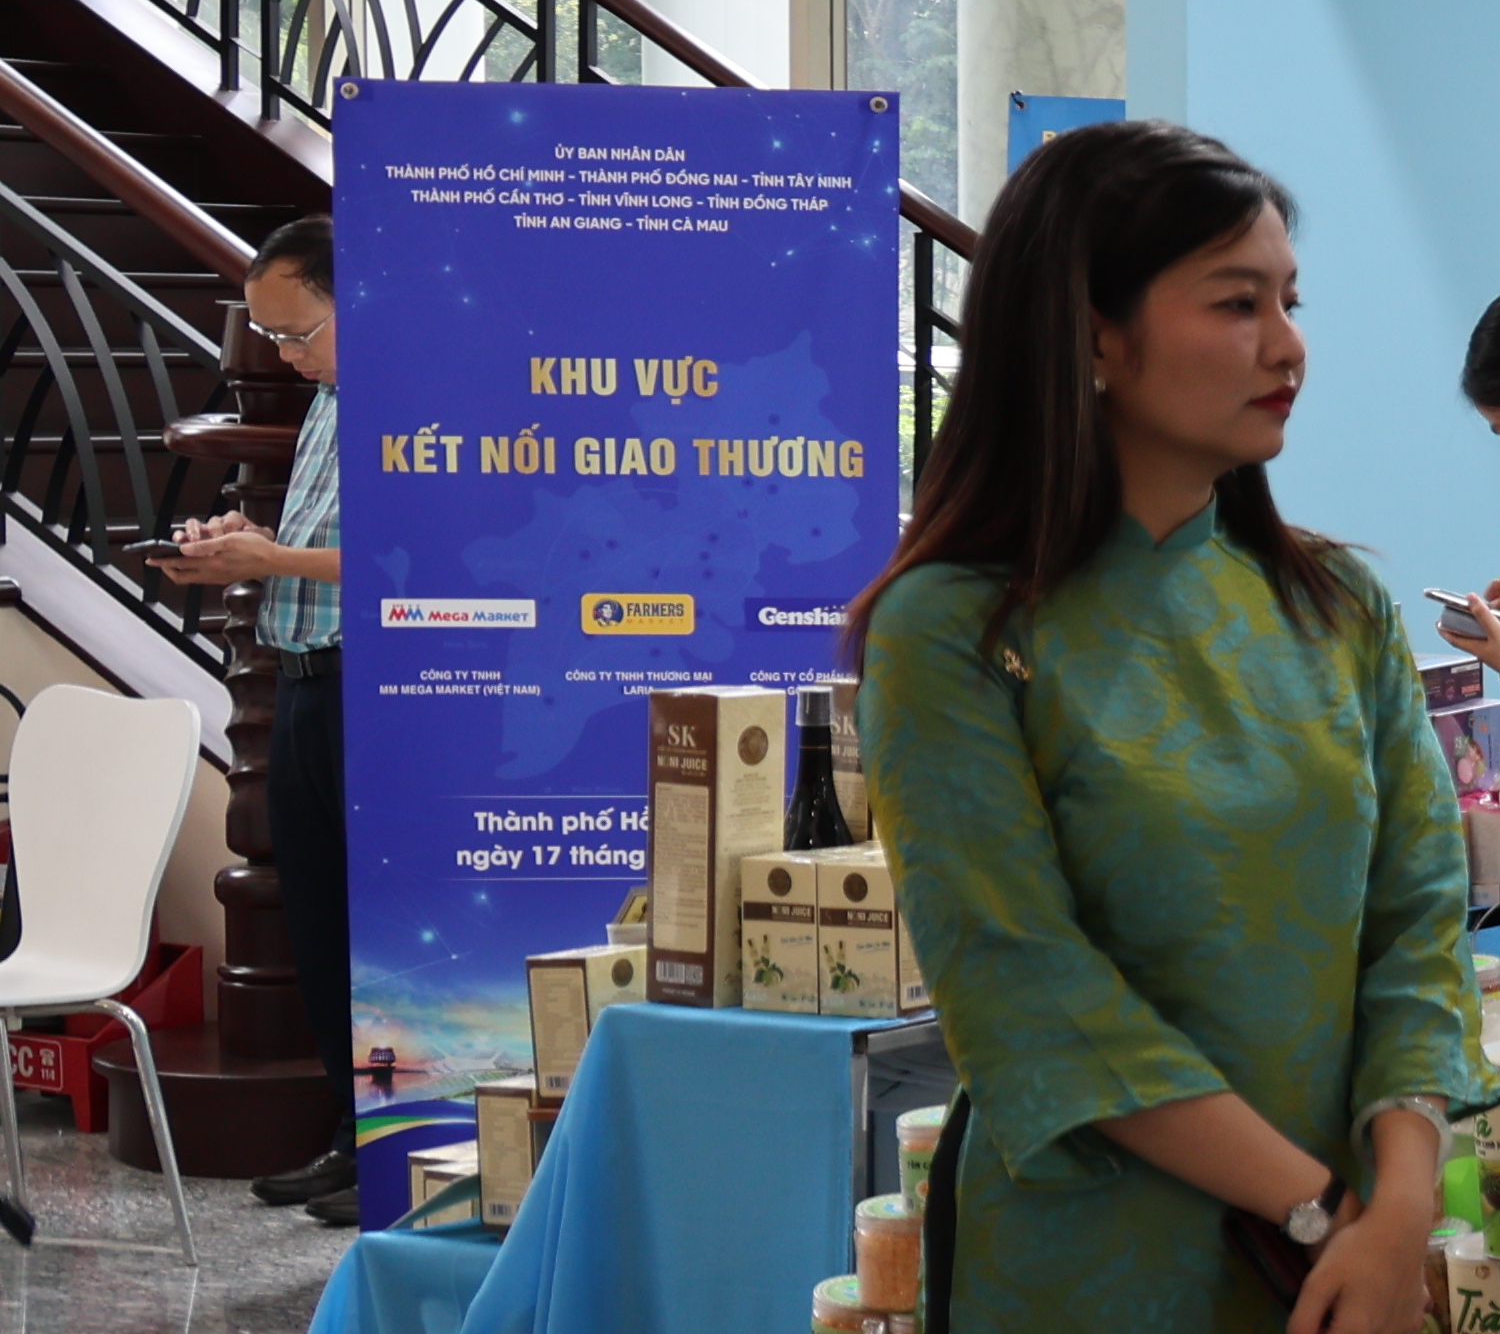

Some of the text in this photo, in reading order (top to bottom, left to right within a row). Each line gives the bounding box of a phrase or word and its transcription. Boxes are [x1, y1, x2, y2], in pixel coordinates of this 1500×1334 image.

[555, 143, 686, 162] ỦY BAN NHÂN DÂN
[385, 163, 852, 189] THÀNH PHỐ HỒ CHÍ MINH THÀNH PHỐ ĐỒNG NAI TỈNH TÂY NINH
[411, 187, 828, 211] THÀNH PHỐ CẦN THƠ TỈNH VĨNH LONG TỈNH ĐỒNG THÁP
[513, 212, 728, 232] TỈNH AN GIANG TỈNH CÀ MAU
[531, 355, 719, 405] KHU VỰC
[381, 423, 864, 478] KẾT NỐI GIAO THƯƠNG
[626, 602, 684, 617] FARMERS
[420, 668, 501, 681] CÔNG TY TNHH
[565, 669, 712, 683] CÔNG TY TNHH THƯƠNG MẠI
[750, 668, 814, 682] CÔNG TY CỔ
[379, 682, 541, 697] MM MEGA MARKET (VIỆT NAM)
[624, 685, 654, 695] LARIA
[668, 725, 697, 748] SK
[680, 757, 708, 772] JUICE
[474, 808, 554, 833] Thành
[562, 806, 615, 835] phố
[456, 844, 646, 871] ngày 17 tháng
